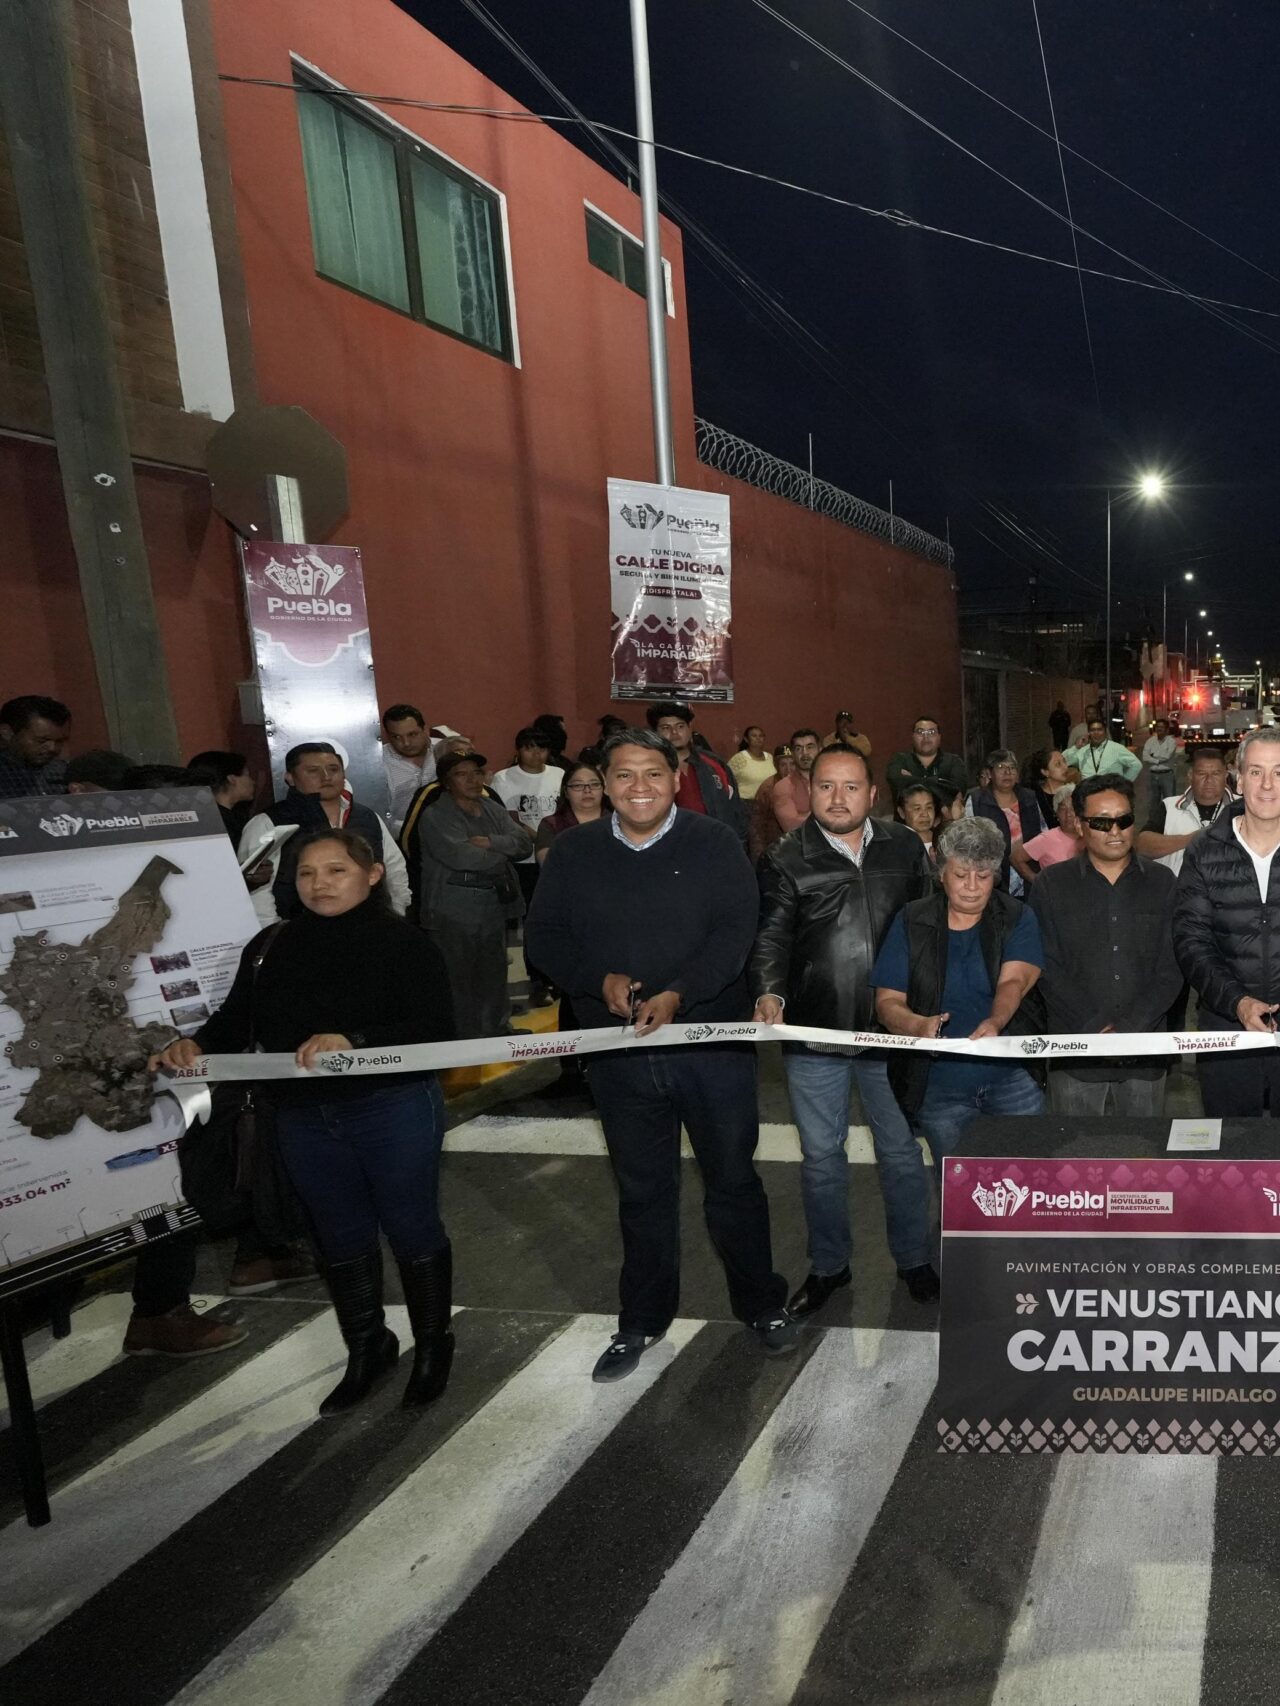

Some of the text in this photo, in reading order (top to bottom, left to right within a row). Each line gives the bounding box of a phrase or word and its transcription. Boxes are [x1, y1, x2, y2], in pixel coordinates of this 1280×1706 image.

[651, 548, 692, 559] TU NUEVA
[616, 555, 669, 570] CALLE
[267, 597, 352, 616] Puebla
[86, 815, 141, 830] Puebla
[717, 1027, 757, 1036] Puebla
[533, 1040, 574, 1048] CAPITAL
[854, 1036, 916, 1047] IMPARABLE
[1050, 1041, 1089, 1051] Puebla
[1178, 1040, 1237, 1050] IMPARABLE
[511, 1044, 576, 1058] IMPARABLE
[357, 1054, 402, 1067] Puebla
[1032, 1190, 1104, 1209] Puebla
[1006, 1260, 1127, 1274] PAVIMENTACIÓN
[1132, 1263, 1141, 1274] Y
[1145, 1263, 1196, 1274] OBRAS
[1072, 1386, 1277, 1403] GUADALUPE HIDALGO
